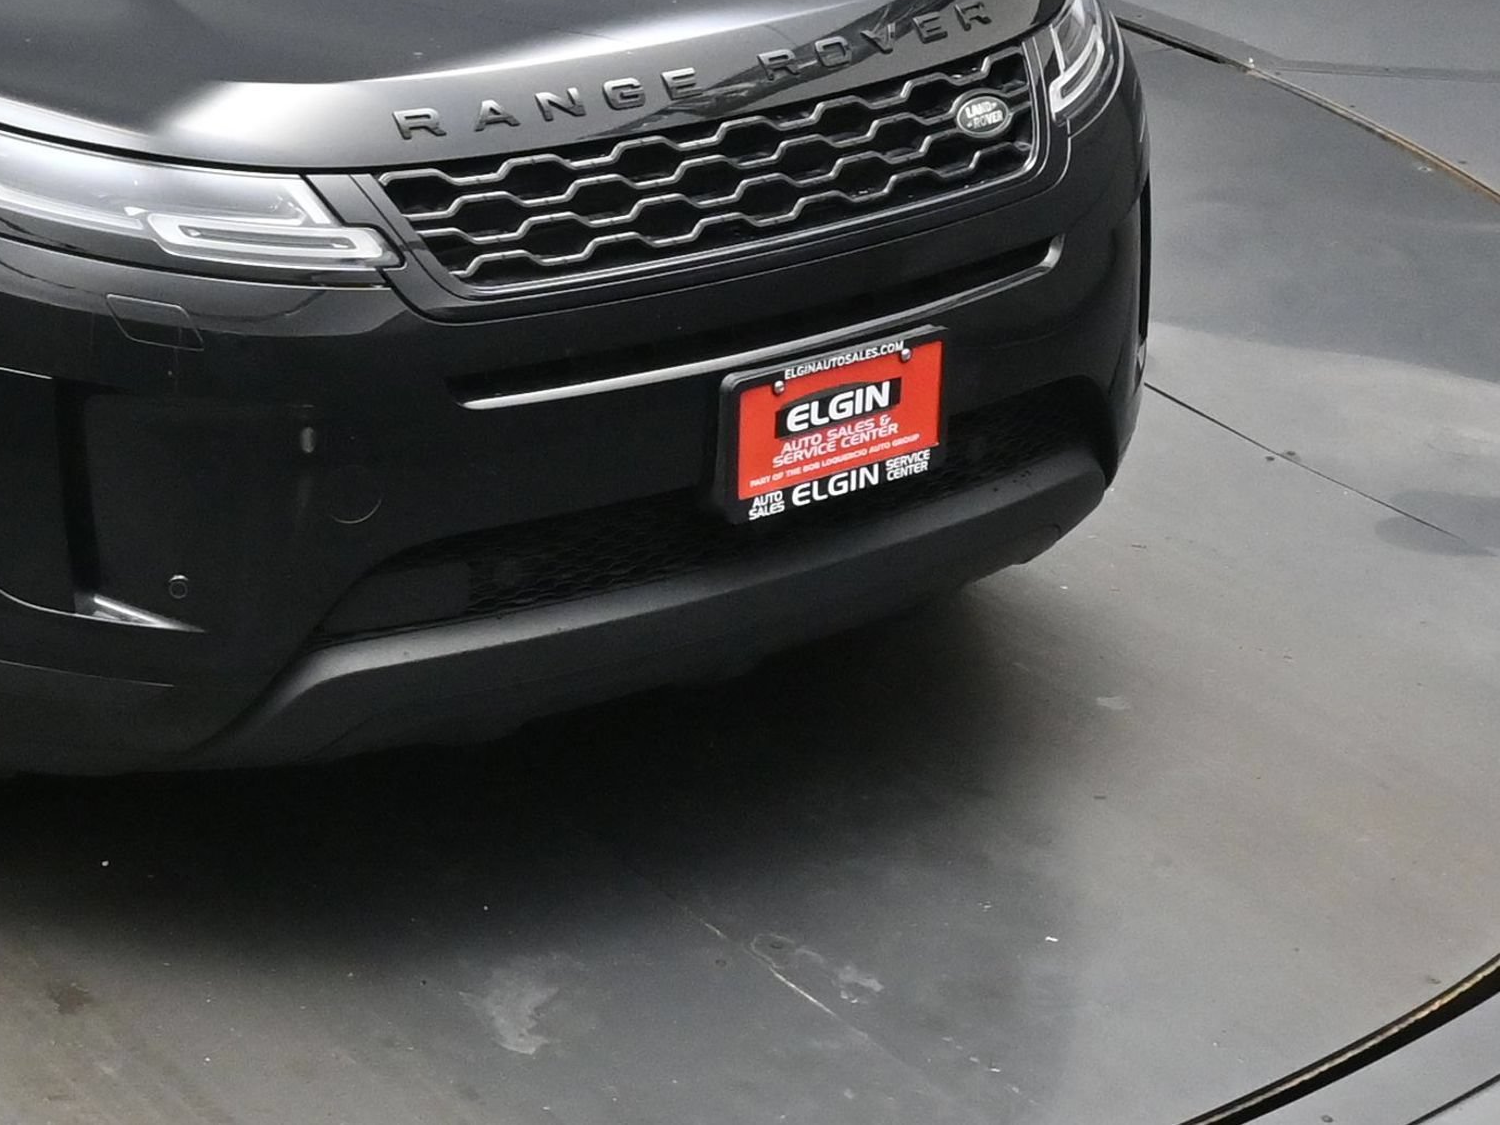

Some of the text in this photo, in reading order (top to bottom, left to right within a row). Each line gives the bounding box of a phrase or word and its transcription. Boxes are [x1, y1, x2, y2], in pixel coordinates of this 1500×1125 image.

[392, 0, 994, 141] RANGE ROVER
[965, 101, 992, 119] LAND
[973, 109, 1003, 129] ROVER
[784, 340, 904, 380] ELGINAUTOSALES.COM
[786, 381, 890, 432] ELGIN
[772, 422, 899, 468] SERVICE CENTER
[781, 414, 891, 454] AUTO SALES &
[750, 477, 771, 487] PART
[772, 472, 785, 481] OF
[786, 468, 801, 477] THE
[869, 442, 891, 454] AUTO
[892, 433, 920, 447] GROUP
[886, 449, 931, 471] SERVICE
[887, 461, 929, 481] CENTER
[752, 490, 783, 508] AUTO
[792, 463, 879, 506] ELGIN
[748, 503, 785, 521] SALES
